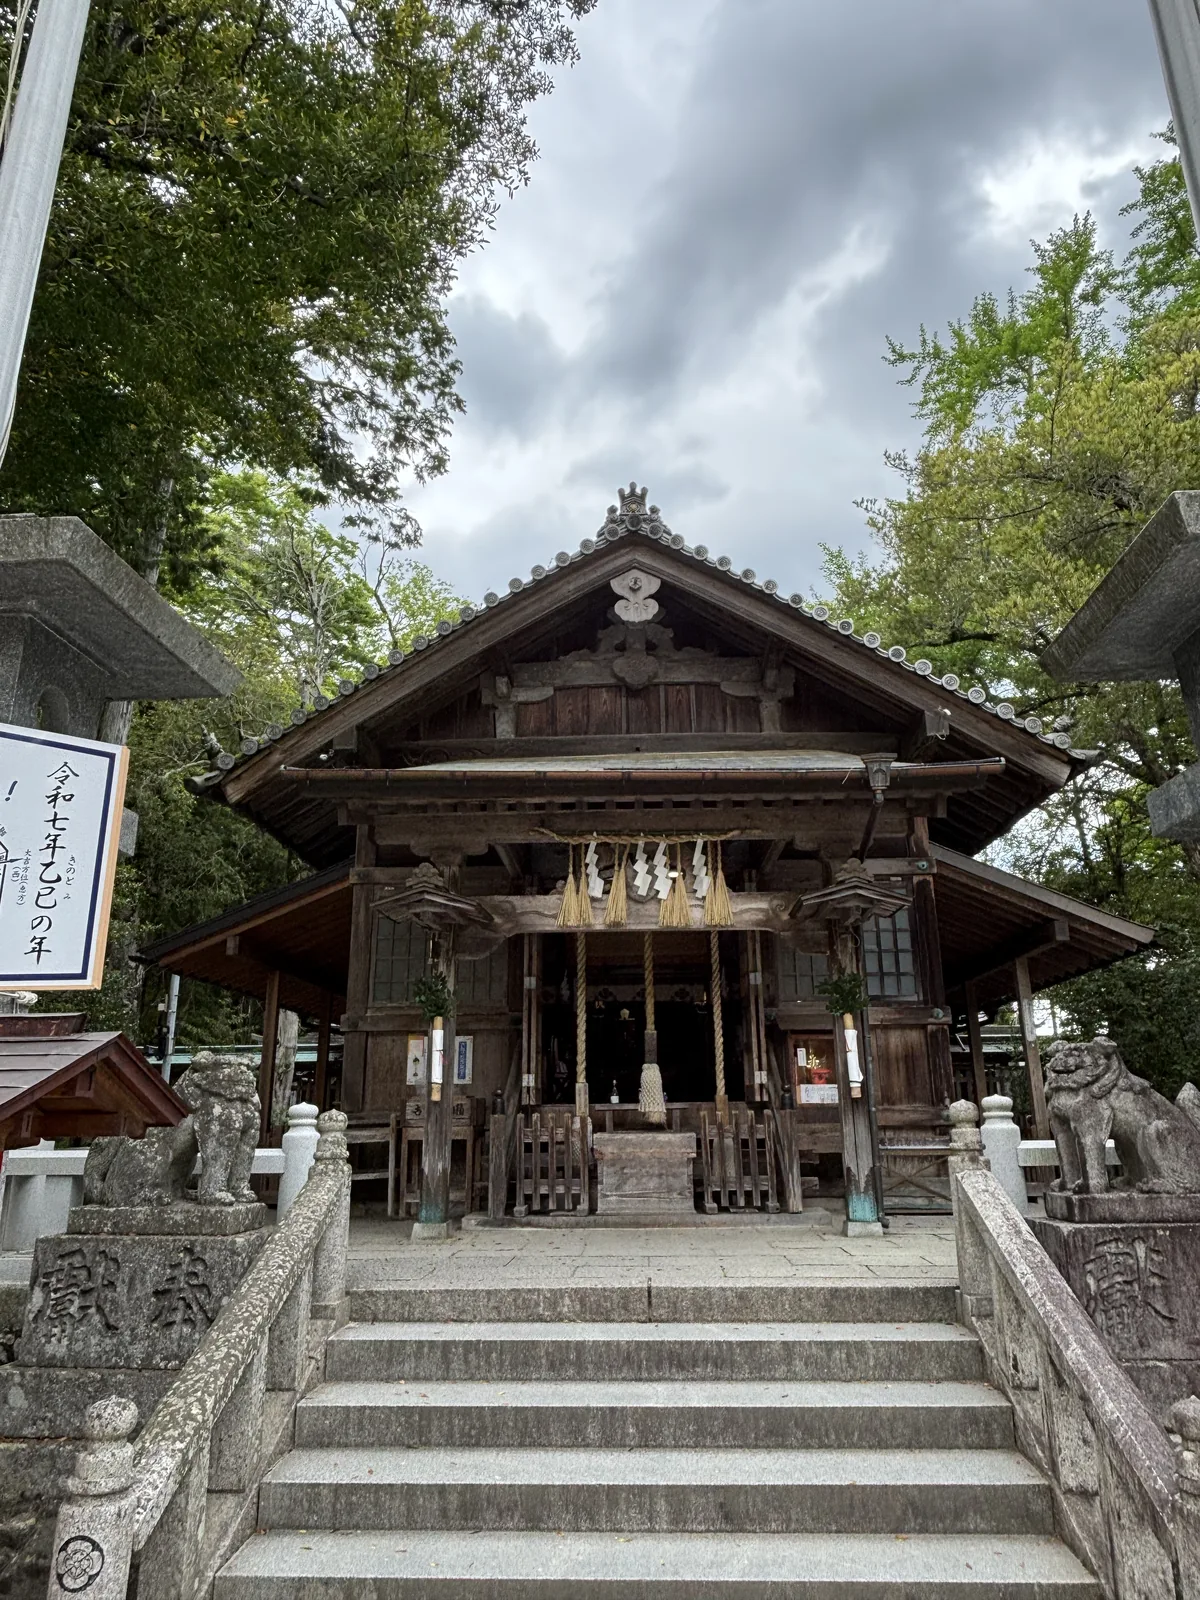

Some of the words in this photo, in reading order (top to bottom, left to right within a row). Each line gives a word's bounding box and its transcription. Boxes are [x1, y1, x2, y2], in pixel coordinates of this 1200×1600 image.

[24, 761, 80, 965] 令和七年乙巳の年
